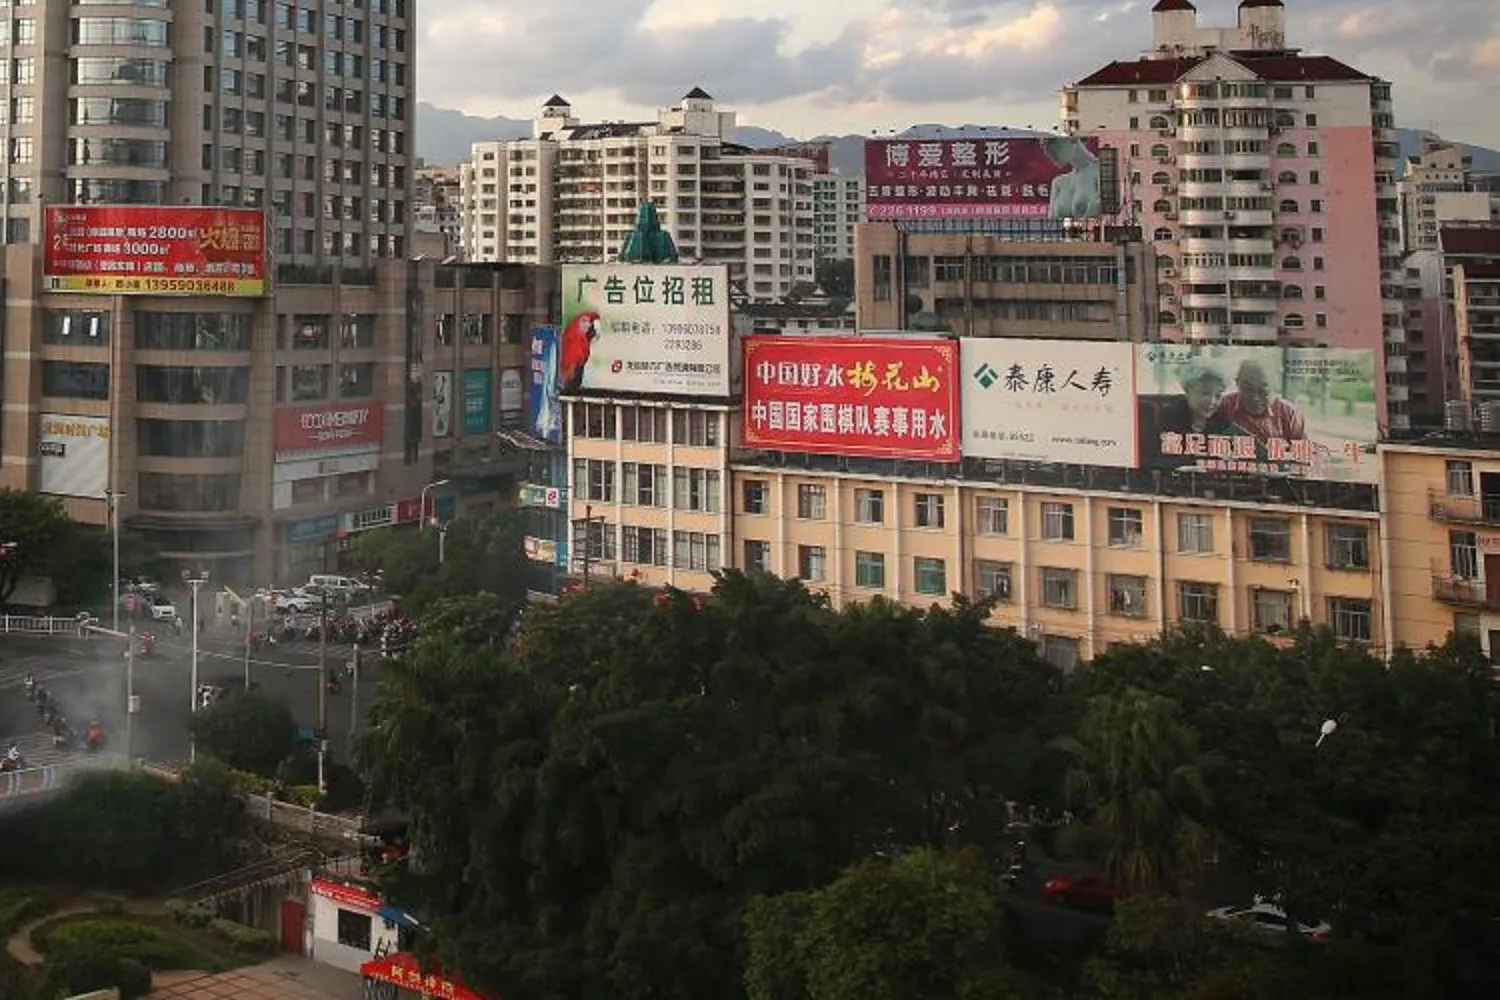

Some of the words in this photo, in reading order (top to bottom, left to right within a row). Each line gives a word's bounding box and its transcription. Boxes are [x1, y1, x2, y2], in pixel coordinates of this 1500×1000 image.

[885, 141, 1011, 168] 博爱整形
[576, 275, 715, 306] 广告位招租
[1003, 363, 1115, 397] 泰康人寿
[750, 400, 947, 440] 中国国家围棋队赛事用水
